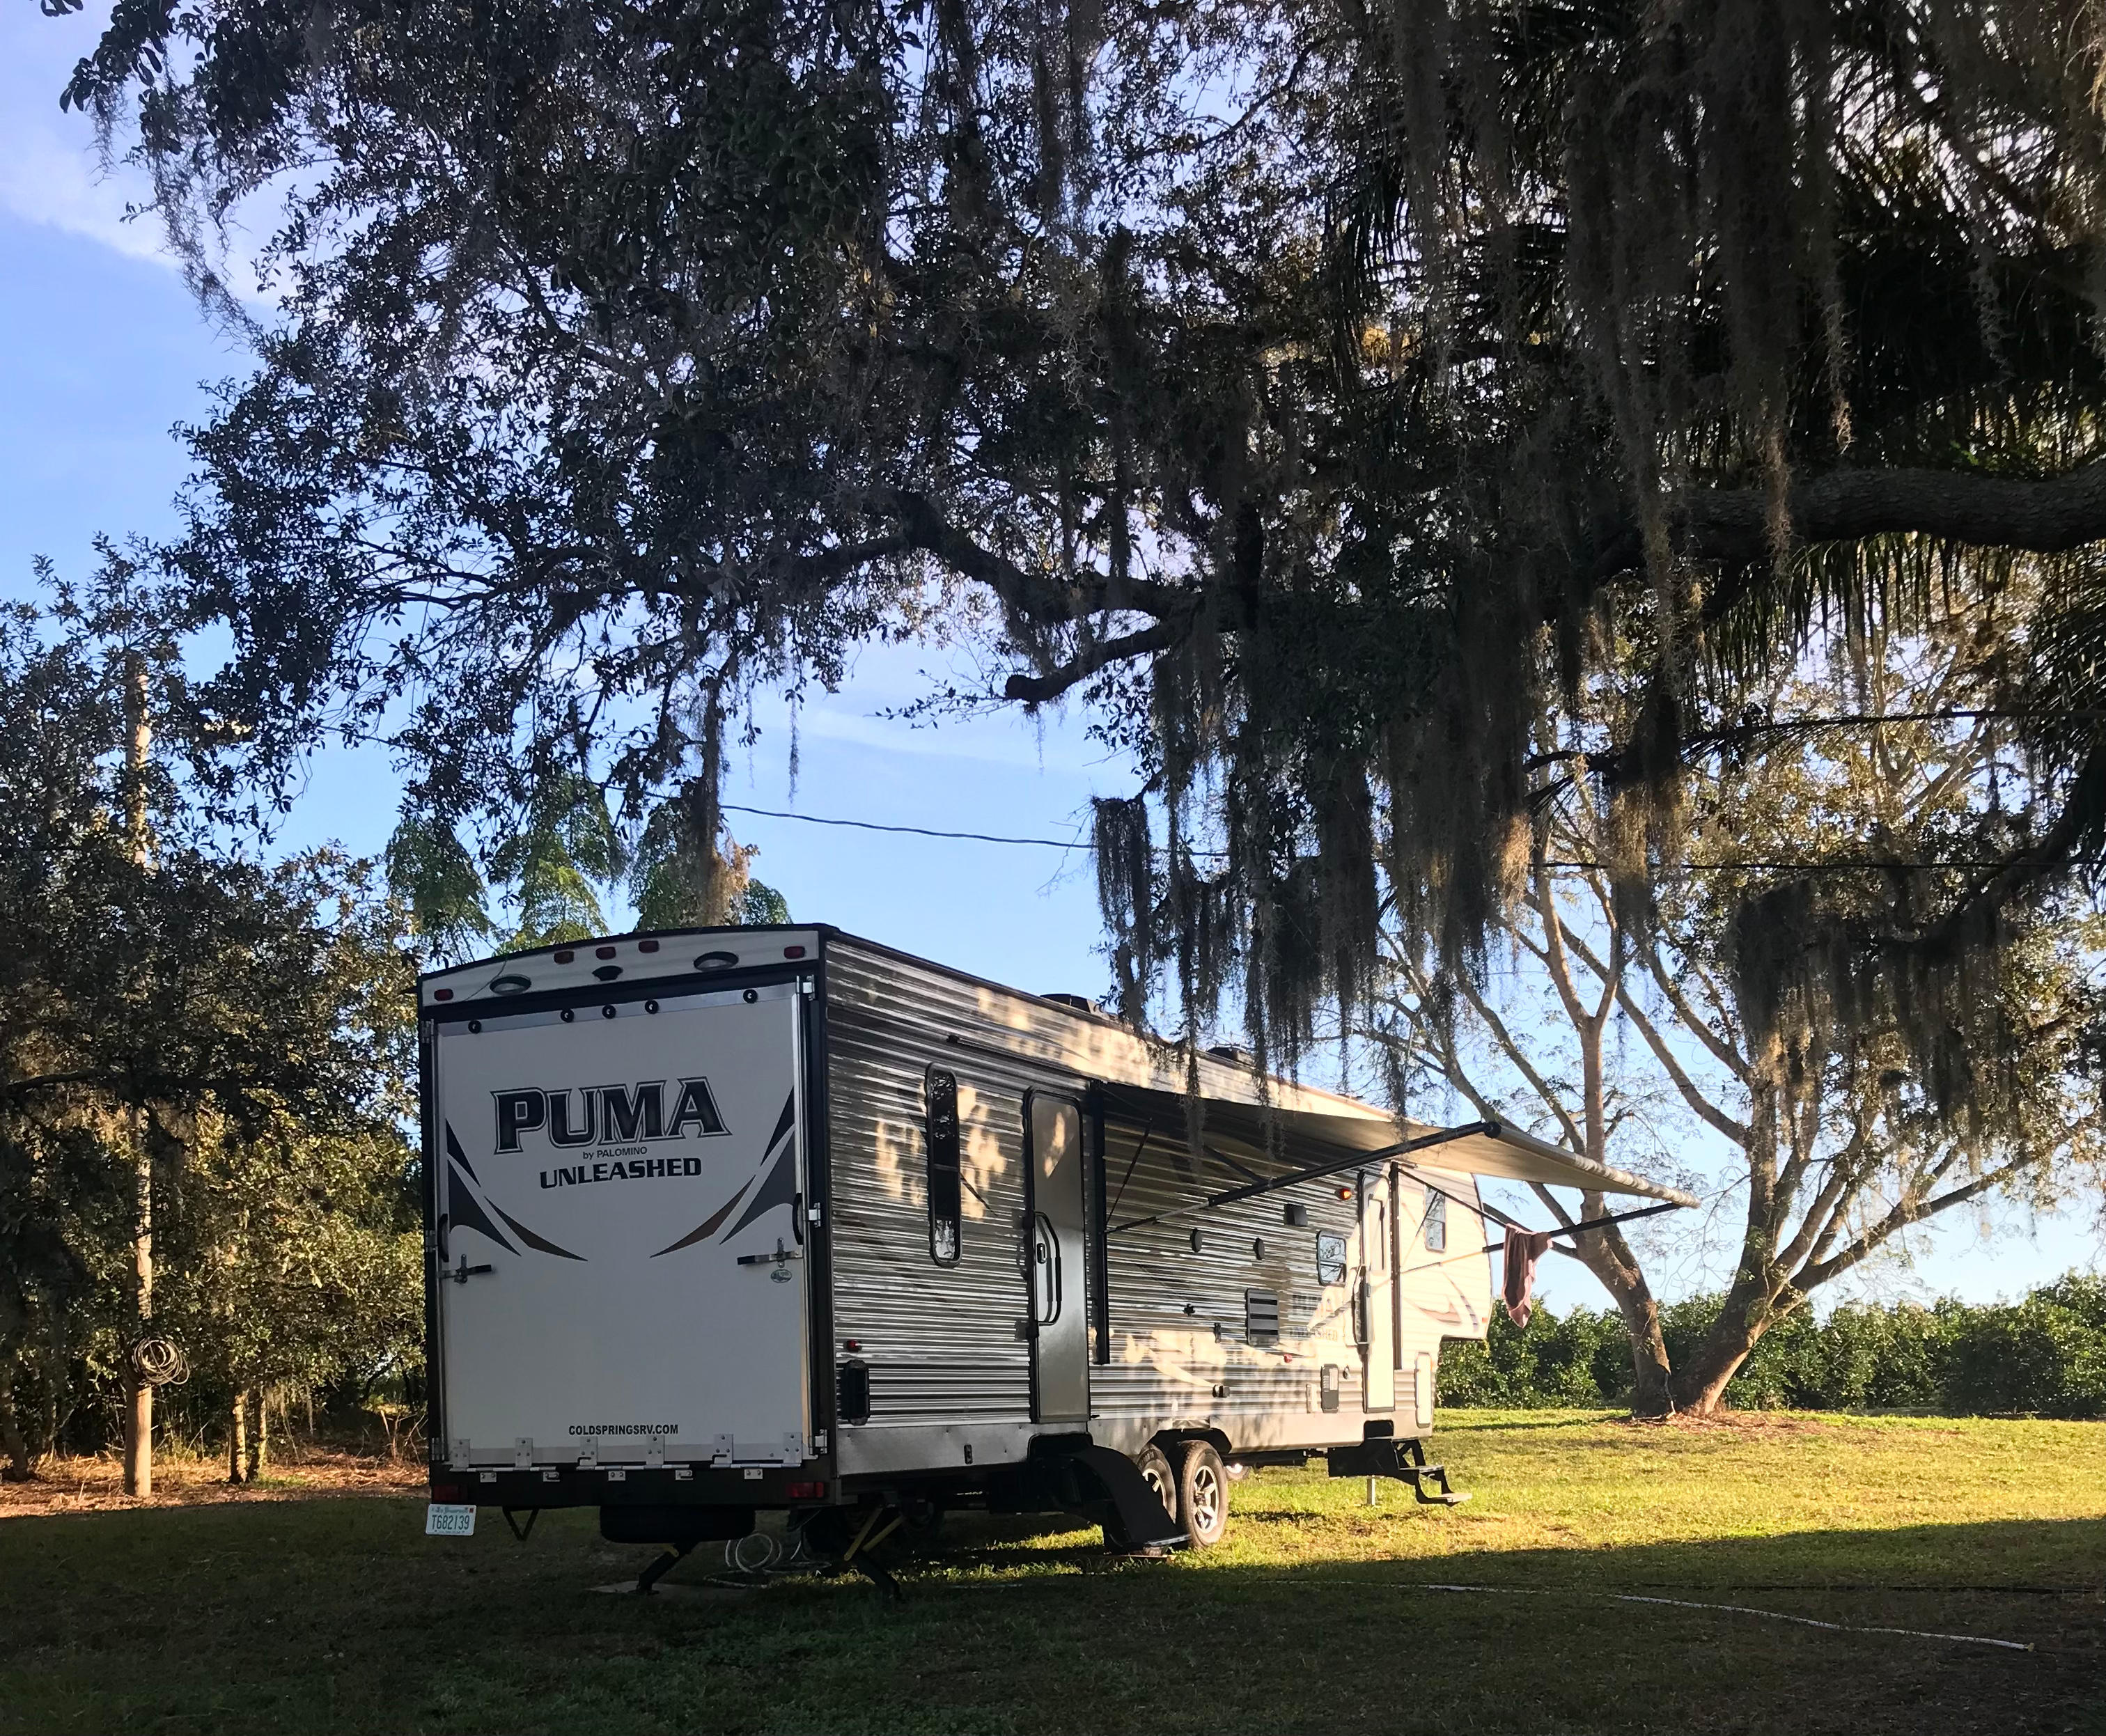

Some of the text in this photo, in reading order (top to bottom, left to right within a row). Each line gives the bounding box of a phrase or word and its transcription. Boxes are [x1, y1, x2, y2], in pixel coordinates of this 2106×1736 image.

[490, 1076, 732, 1155] PUMA
[582, 1146, 648, 1160] by PALOMINO
[540, 1157, 702, 1189] UNLEASHED
[568, 1424, 678, 1435] COLDSPRINGSRV.COM
[431, 1515, 470, 1530] T682139
